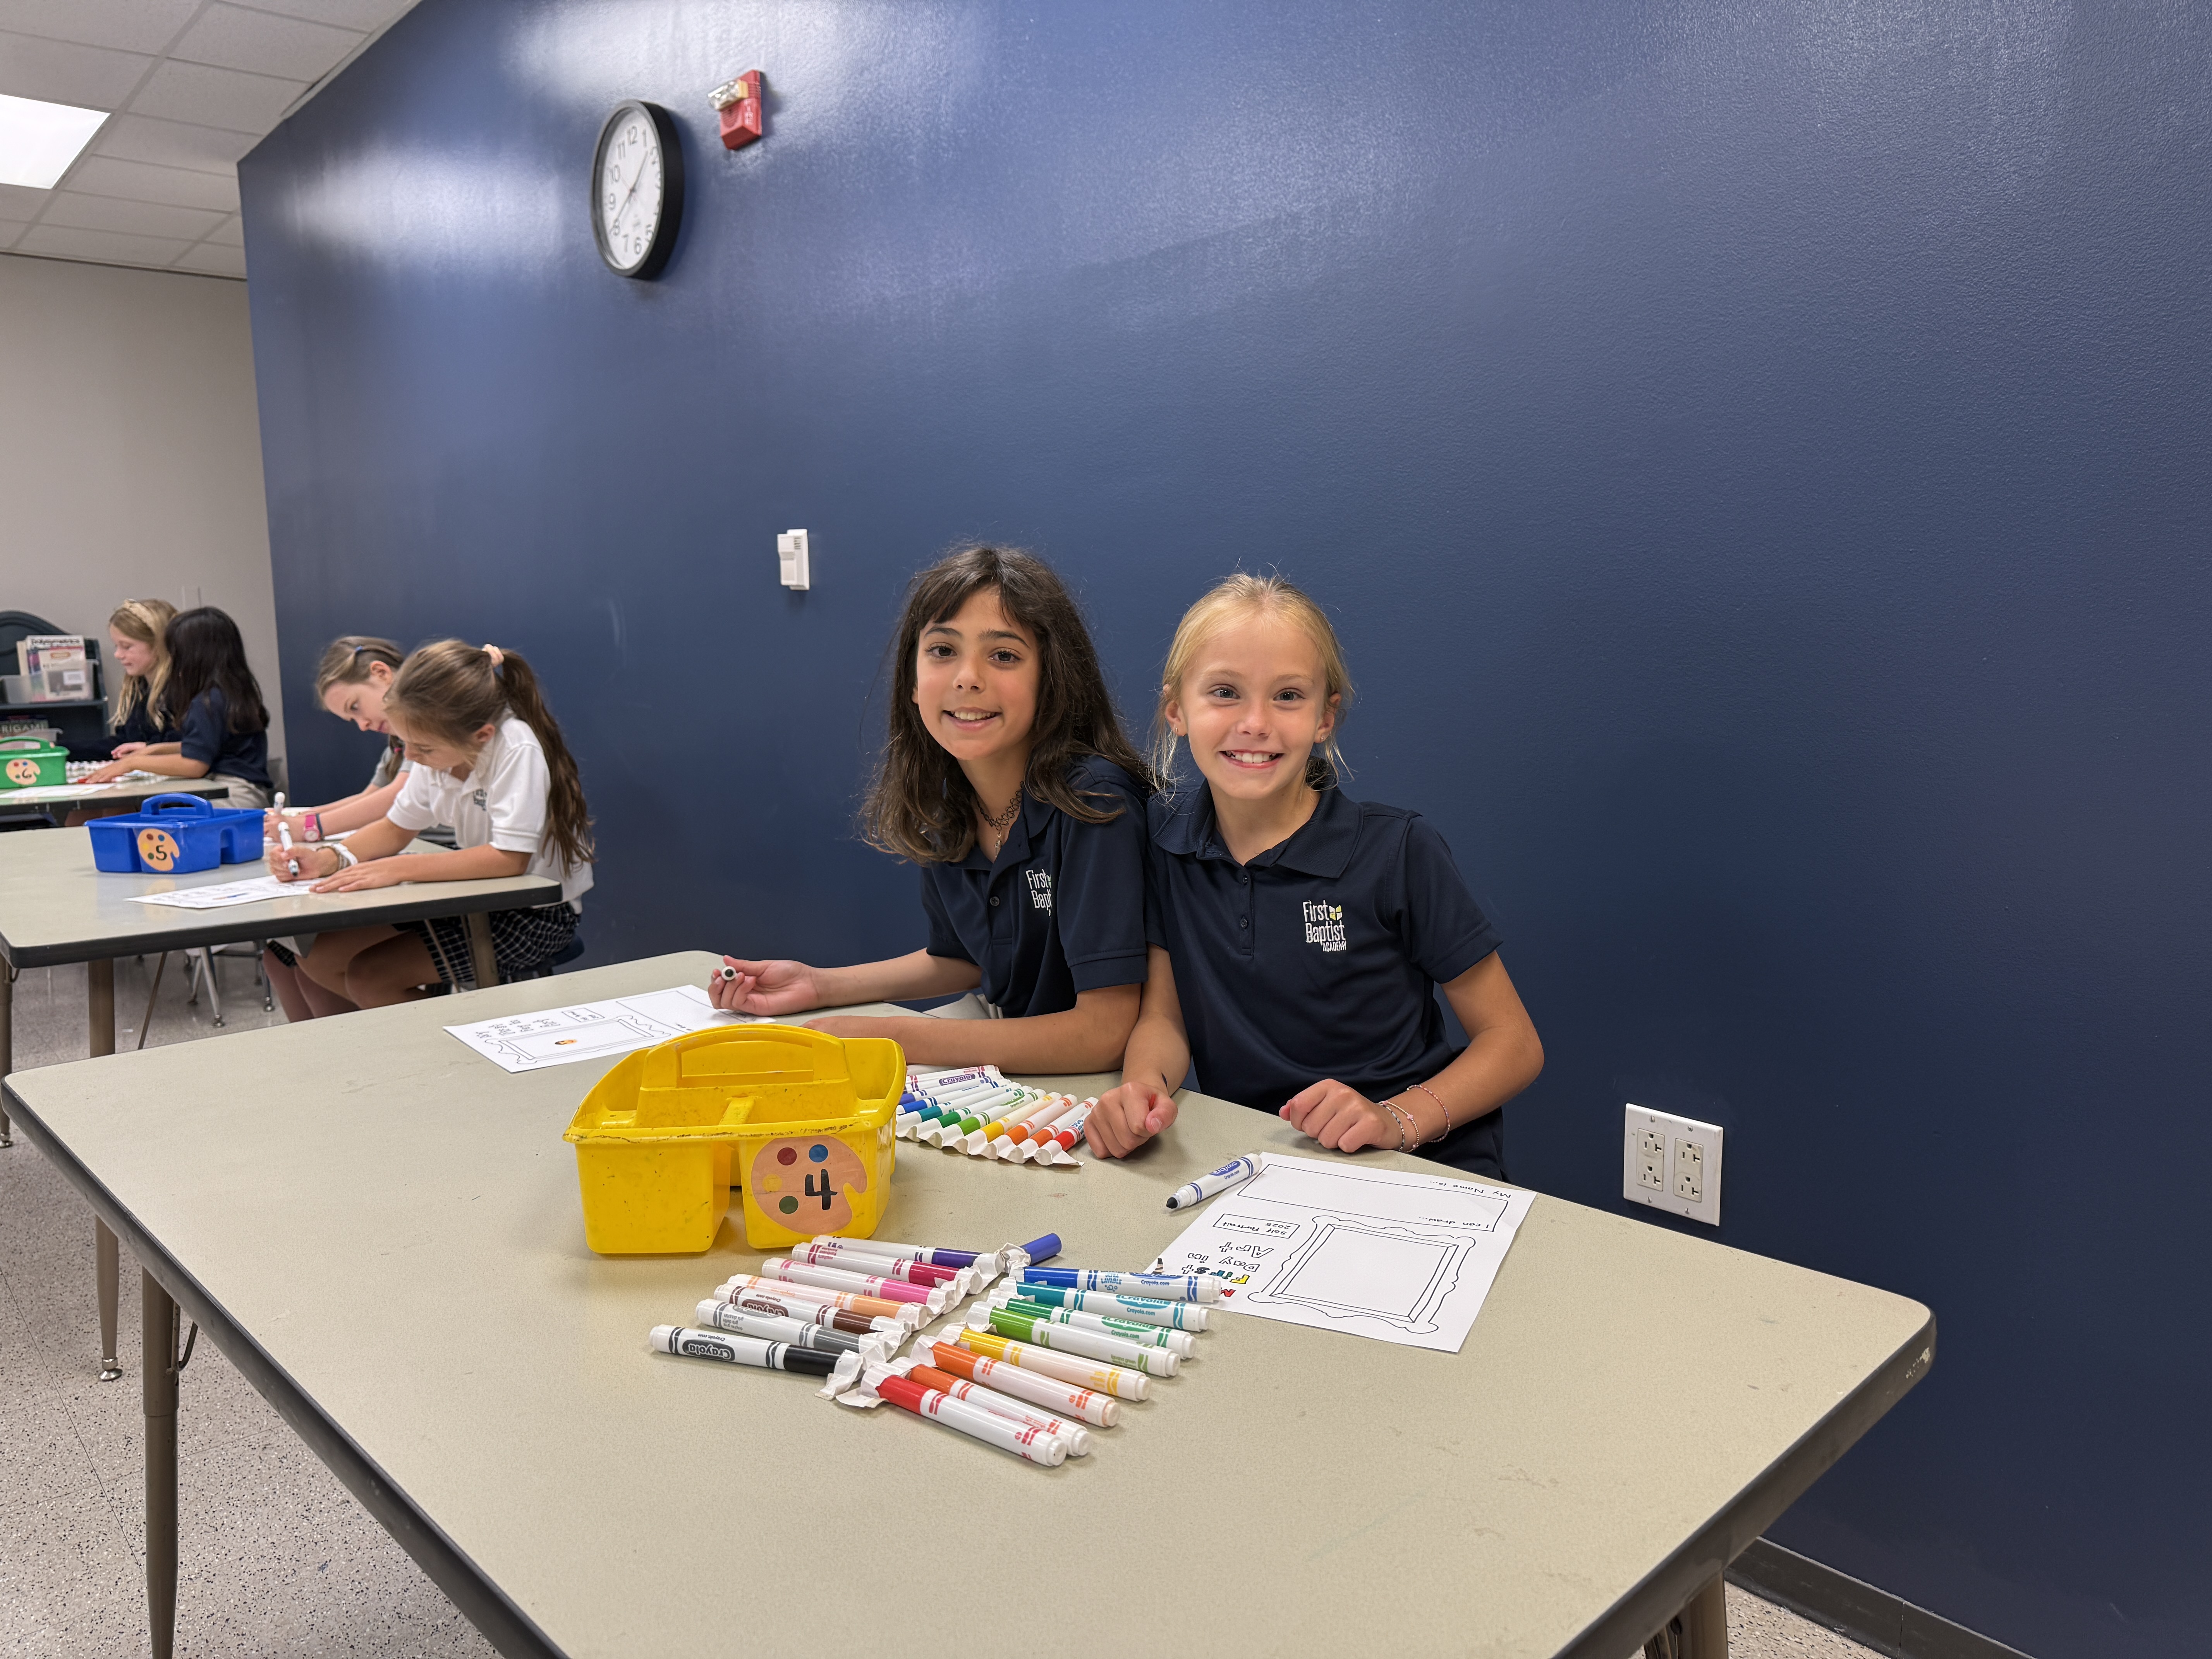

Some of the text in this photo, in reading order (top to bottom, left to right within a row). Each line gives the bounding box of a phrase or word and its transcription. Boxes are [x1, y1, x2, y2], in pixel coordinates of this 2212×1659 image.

[627, 125, 637, 146] 12
[642, 128, 647, 148] 1
[618, 139, 626, 160] 11
[609, 164, 620, 185] 10
[608, 193, 616, 211] 9
[613, 219, 621, 236] 8
[622, 234, 629, 252] 7
[634, 237, 642, 255] 6
[156, 845, 167, 861] 5
[1026, 869, 1049, 890] First
[1031, 889, 1052, 911] Bapti
[1303, 900, 1329, 922] First
[1305, 920, 1346, 946] Baptist
[1323, 940, 1346, 952] ACADEMY
[941, 1074, 972, 1084] Crayola
[804, 1169, 838, 1211] 4
[1453, 1184, 1484, 1194] Name
[1223, 1221, 1260, 1231] Portrait
[1219, 1242, 1274, 1258] Art
[1187, 1253, 1261, 1272] Day in
[1181, 1264, 1250, 1284] First
[756, 1294, 781, 1303] Crayola.com
[1220, 1287, 1237, 1297] M
[1127, 1307, 1155, 1316] Crayola.com
[697, 1333, 725, 1342] Crayola.com
[689, 1343, 732, 1360] Crayola
